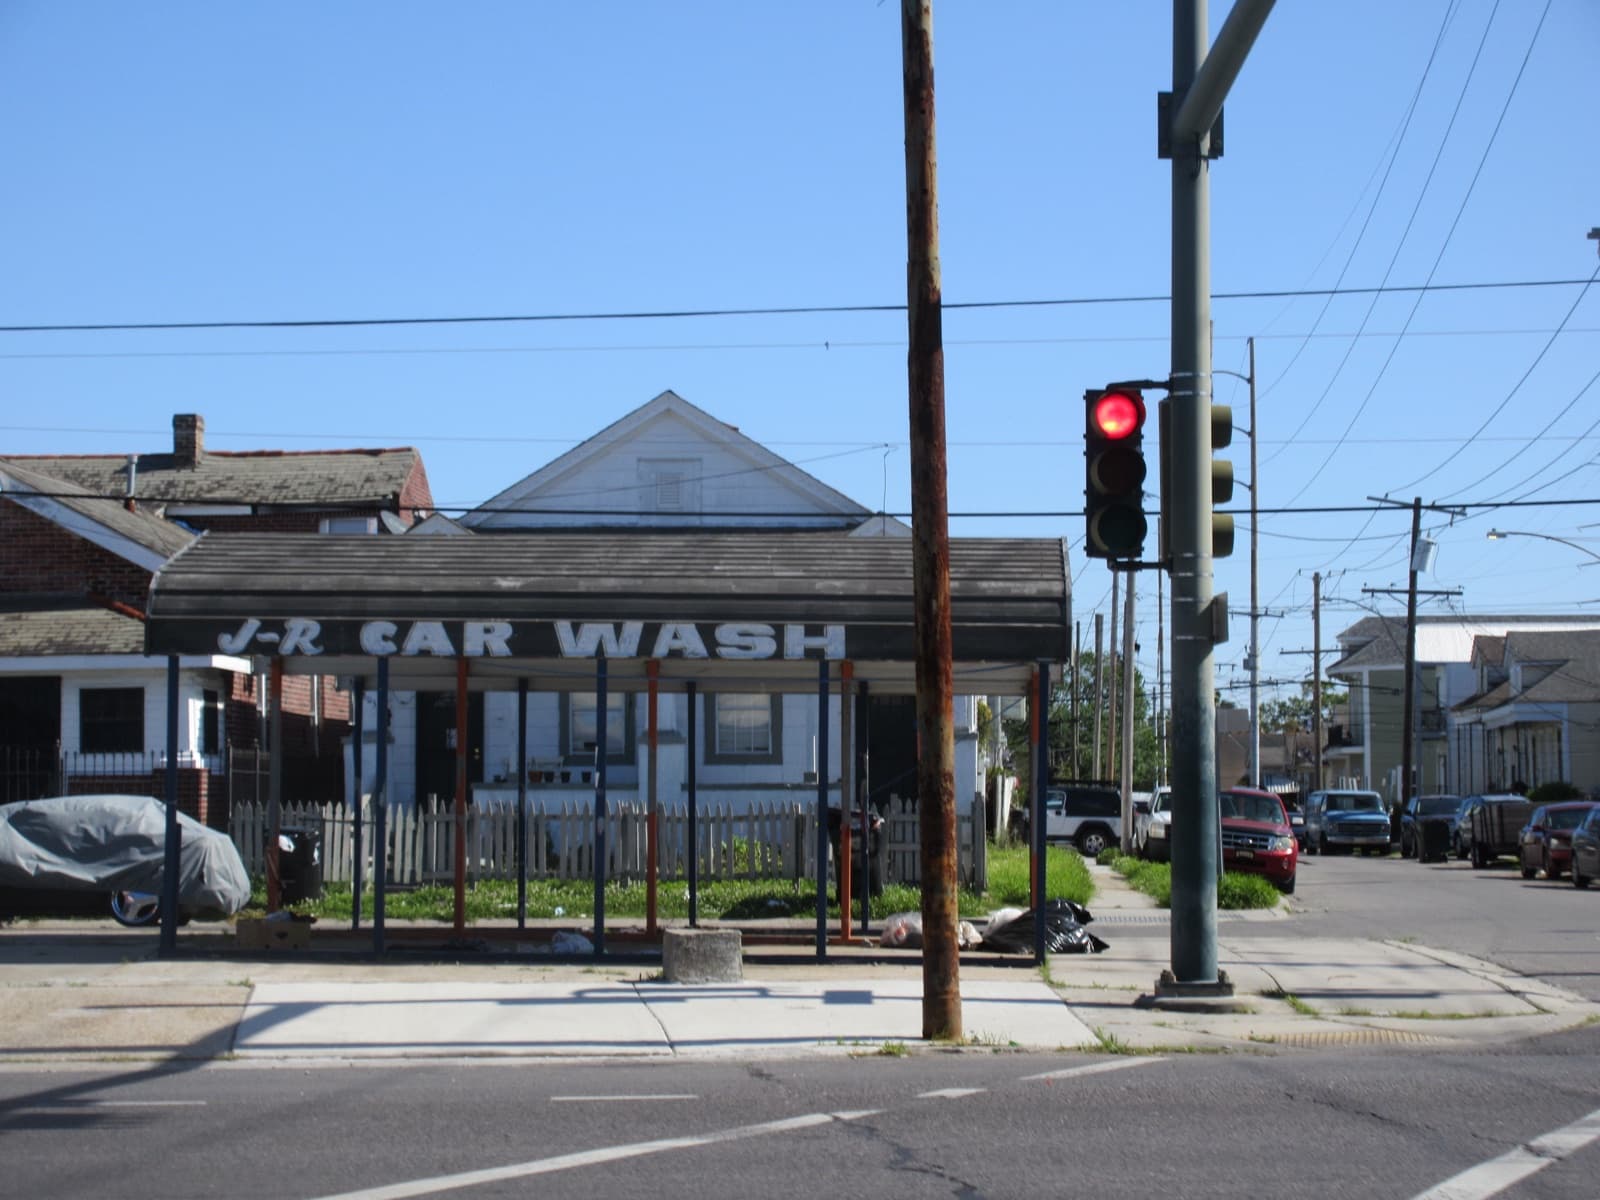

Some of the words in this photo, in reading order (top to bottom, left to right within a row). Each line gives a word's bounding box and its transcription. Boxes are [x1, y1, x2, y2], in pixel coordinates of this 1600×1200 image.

[217, 617, 324, 656] J-R
[359, 619, 513, 658] CAR
[553, 619, 848, 660] WASH
